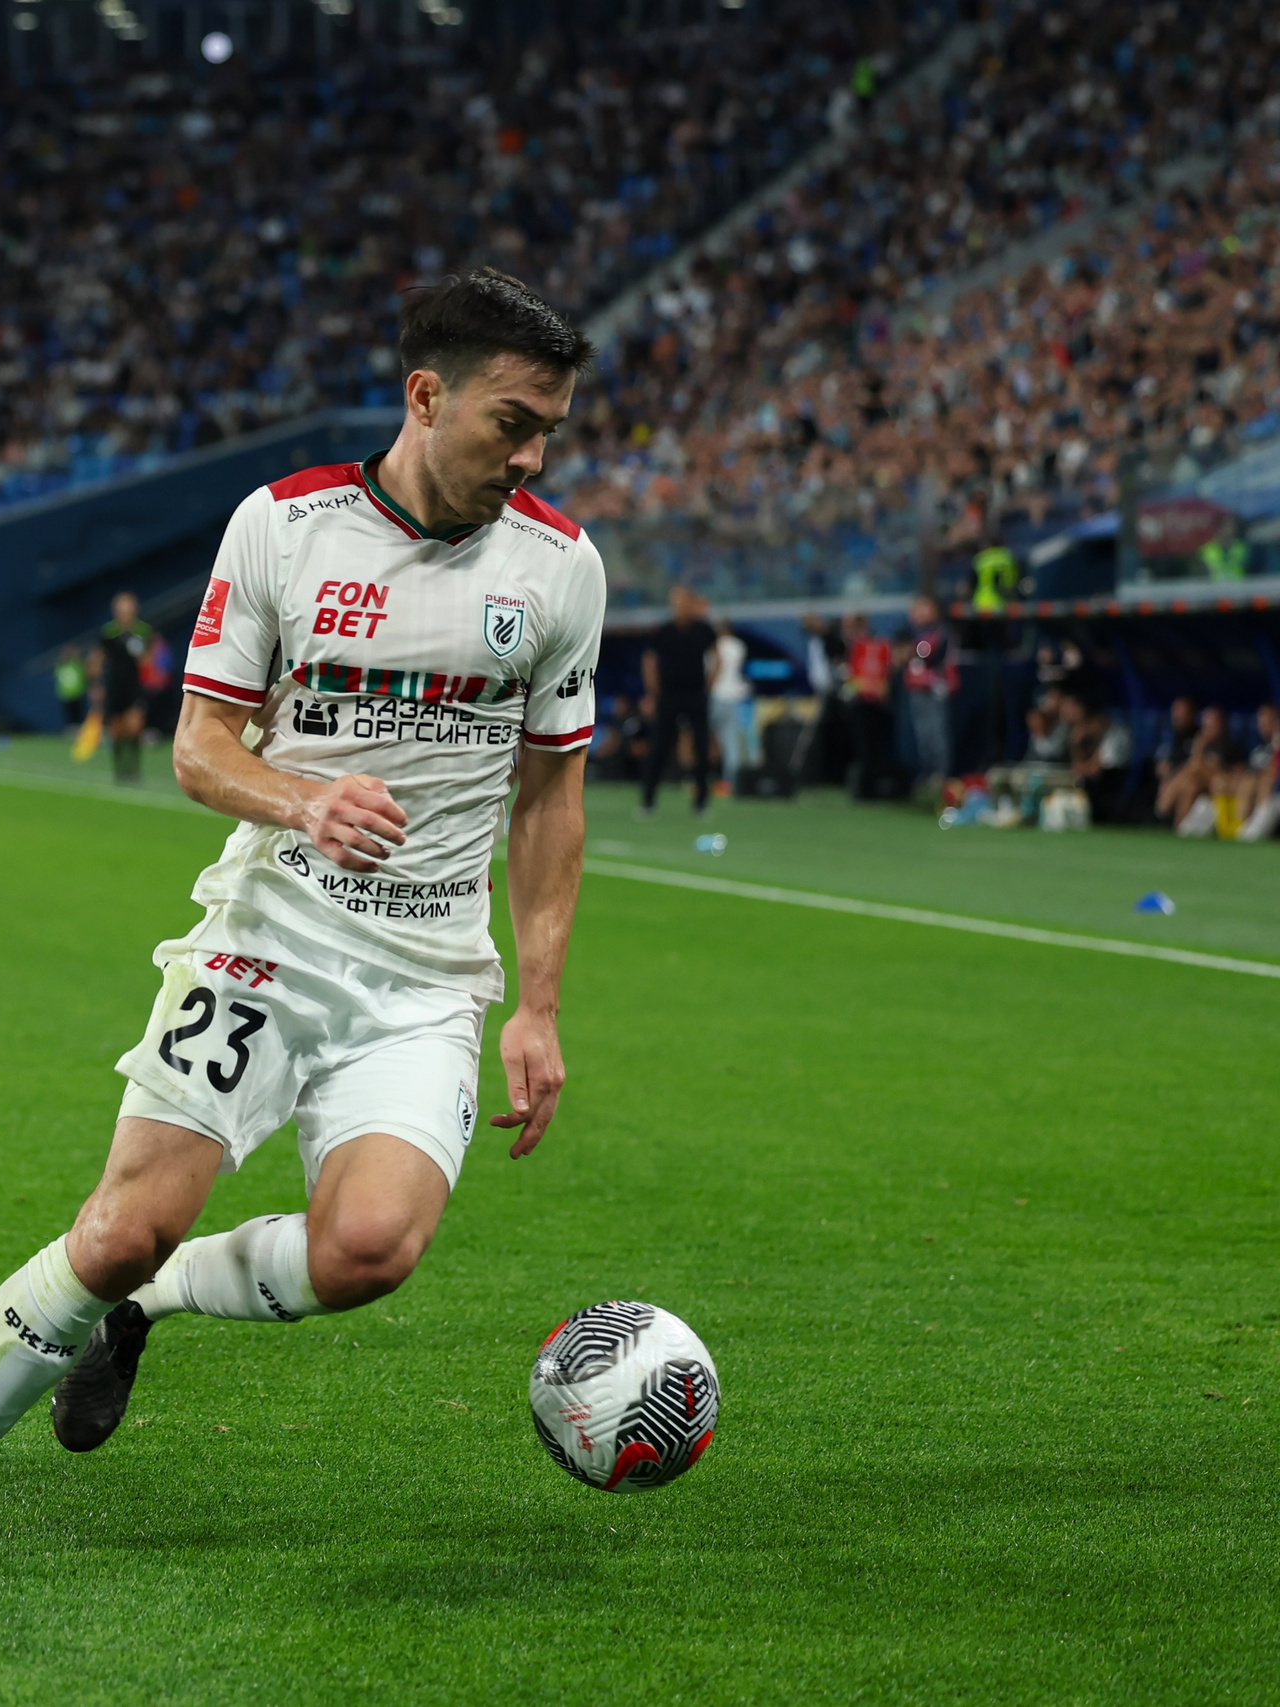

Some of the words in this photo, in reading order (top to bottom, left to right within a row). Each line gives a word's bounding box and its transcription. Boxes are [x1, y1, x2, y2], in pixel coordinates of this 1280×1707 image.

[309, 491, 363, 511] НКНХ
[499, 515, 568, 552] НГОССТРАХ
[315, 580, 390, 609] FON
[485, 594, 525, 608] РУБИН
[312, 607, 388, 639] BET
[353, 718, 512, 745] ОРГСИНТЕЗ
[204, 953, 274, 989] BET
[158, 986, 267, 1093] 23
[4, 1306, 78, 1358] ФКРК
